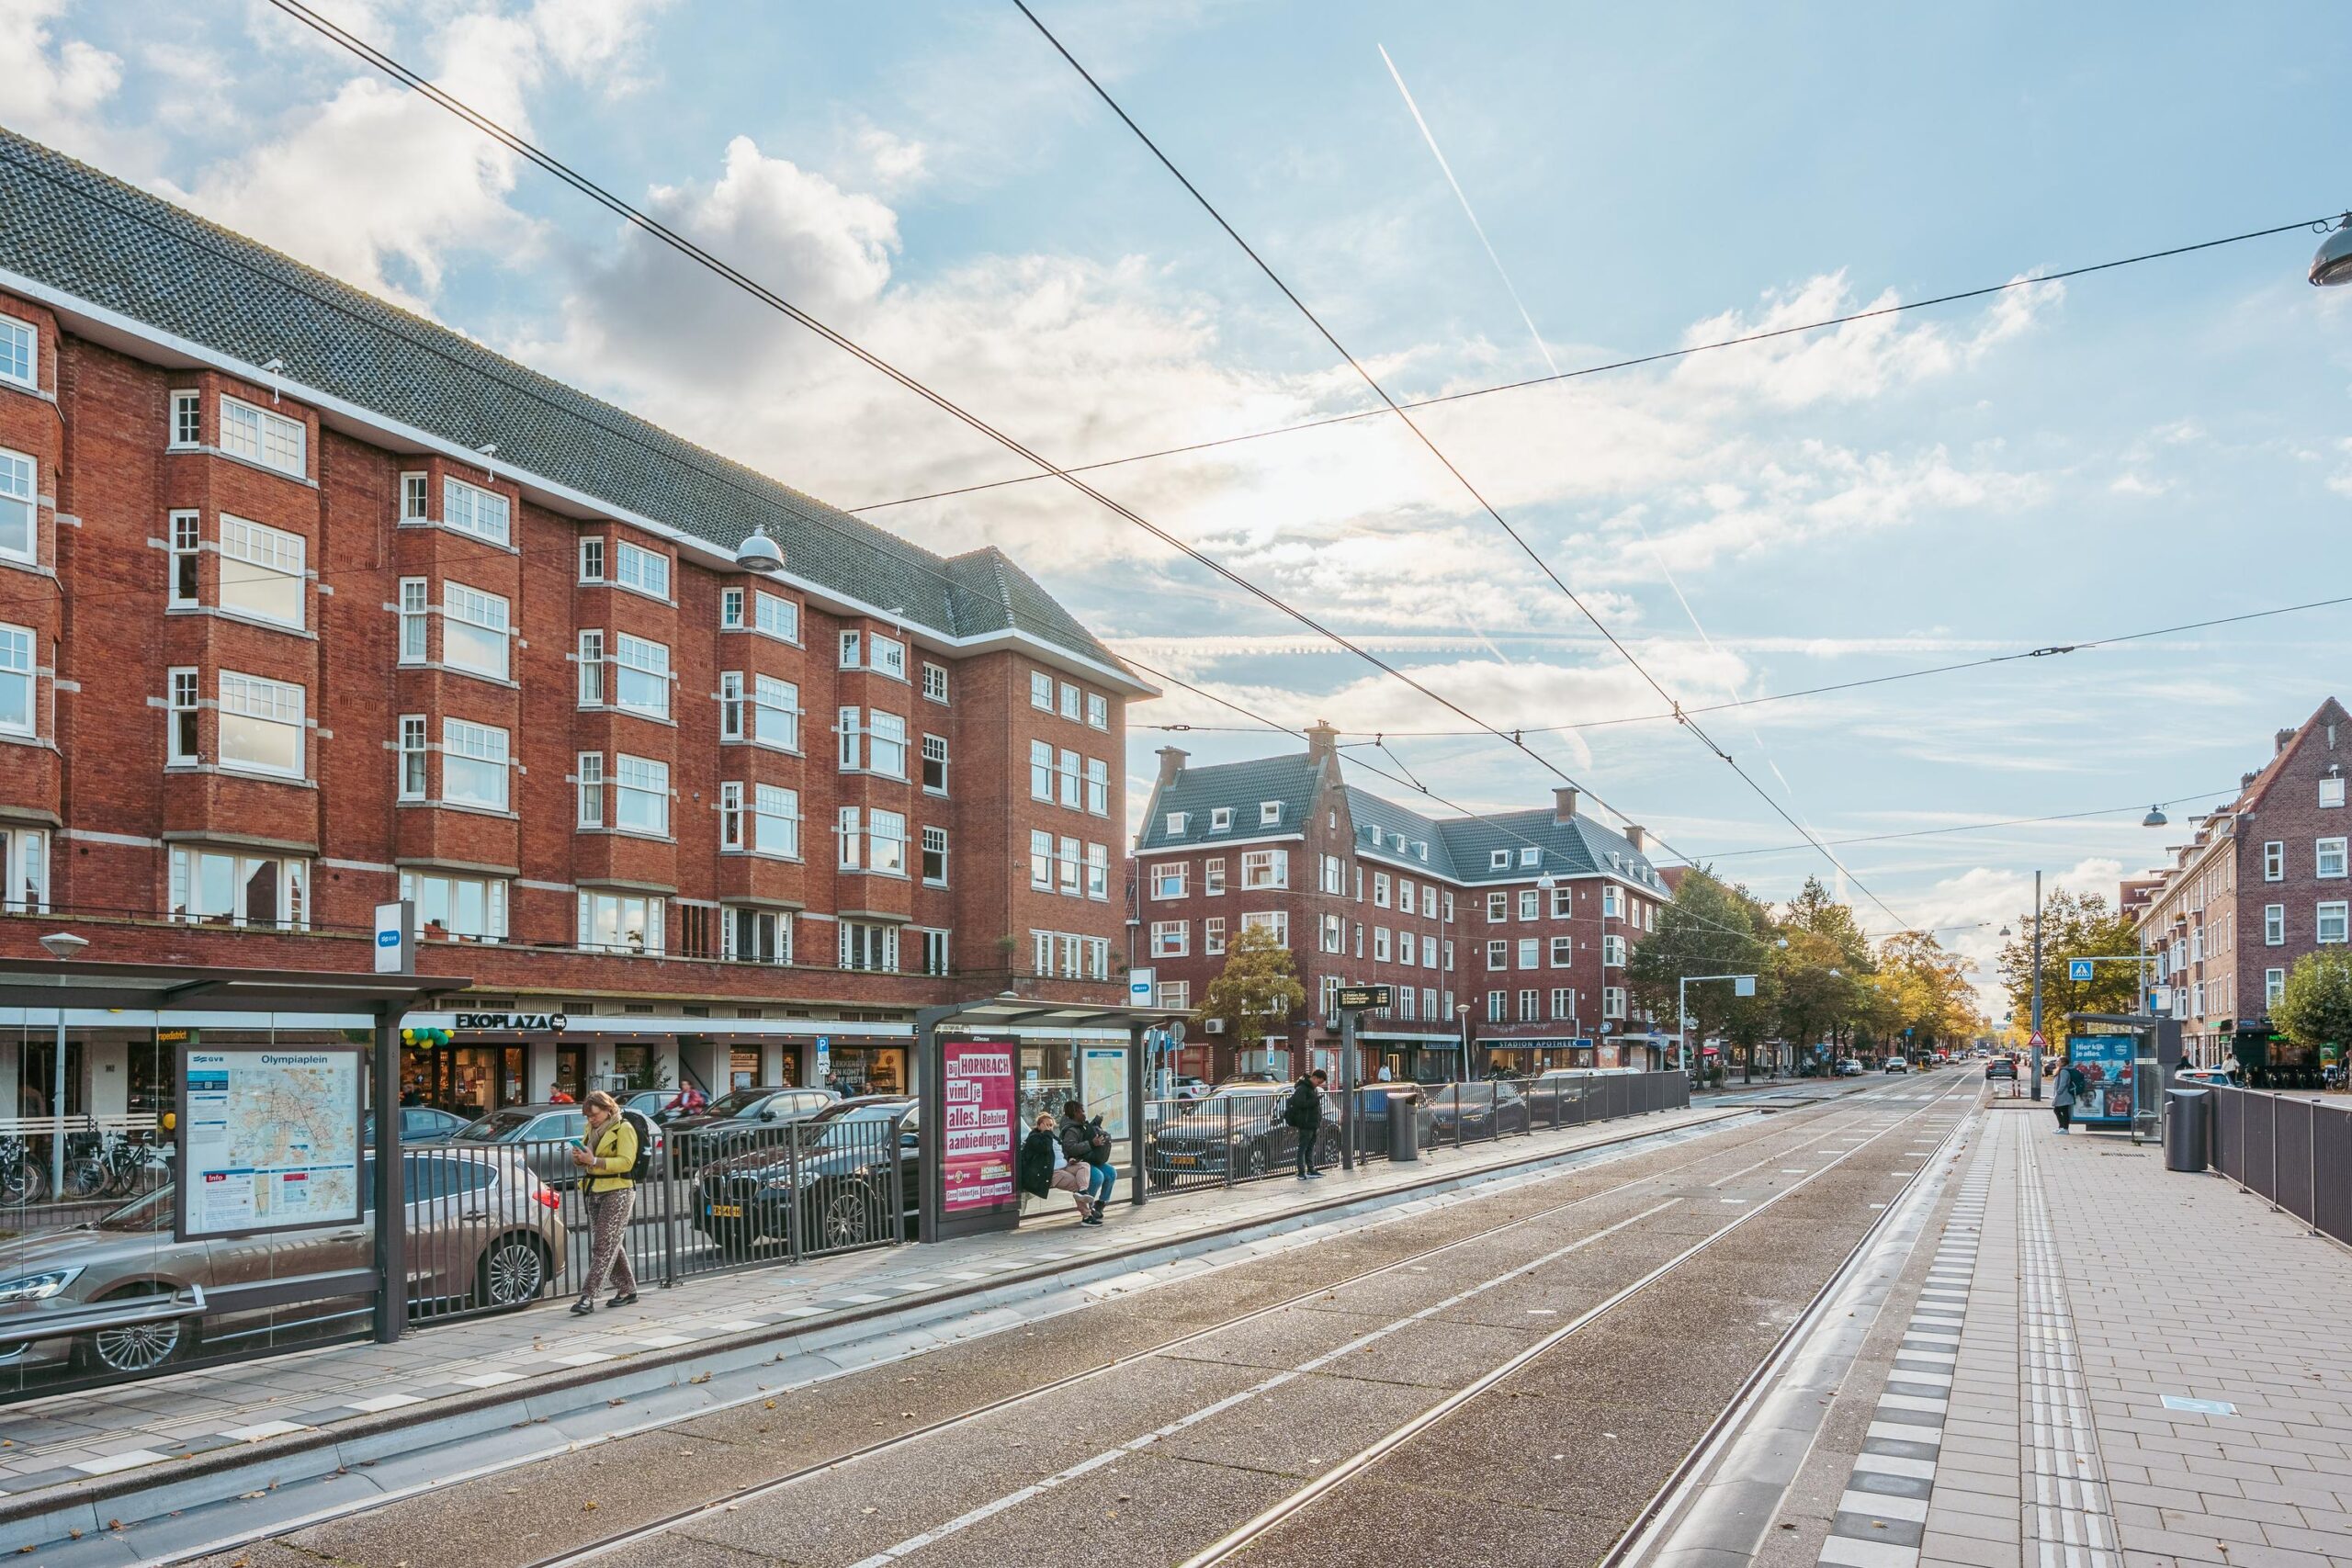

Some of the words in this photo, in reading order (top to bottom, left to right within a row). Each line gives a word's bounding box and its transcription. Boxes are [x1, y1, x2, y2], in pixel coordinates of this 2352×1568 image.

[456, 1013, 548, 1029] EKOPLAZA
[157, 1031, 187, 1042] rapedistrict
[820, 1040, 826, 1051] P
[261, 1055, 328, 1066] Olympiaplein
[948, 1064, 957, 1076] Bij
[961, 1058, 1010, 1074] HORNBACH
[949, 1082, 968, 1100] vind
[974, 1086, 980, 1100] je
[949, 1108, 978, 1127] alles.
[982, 1112, 1006, 1125] Behalve
[949, 1132, 1009, 1150] aanbiedingen.
